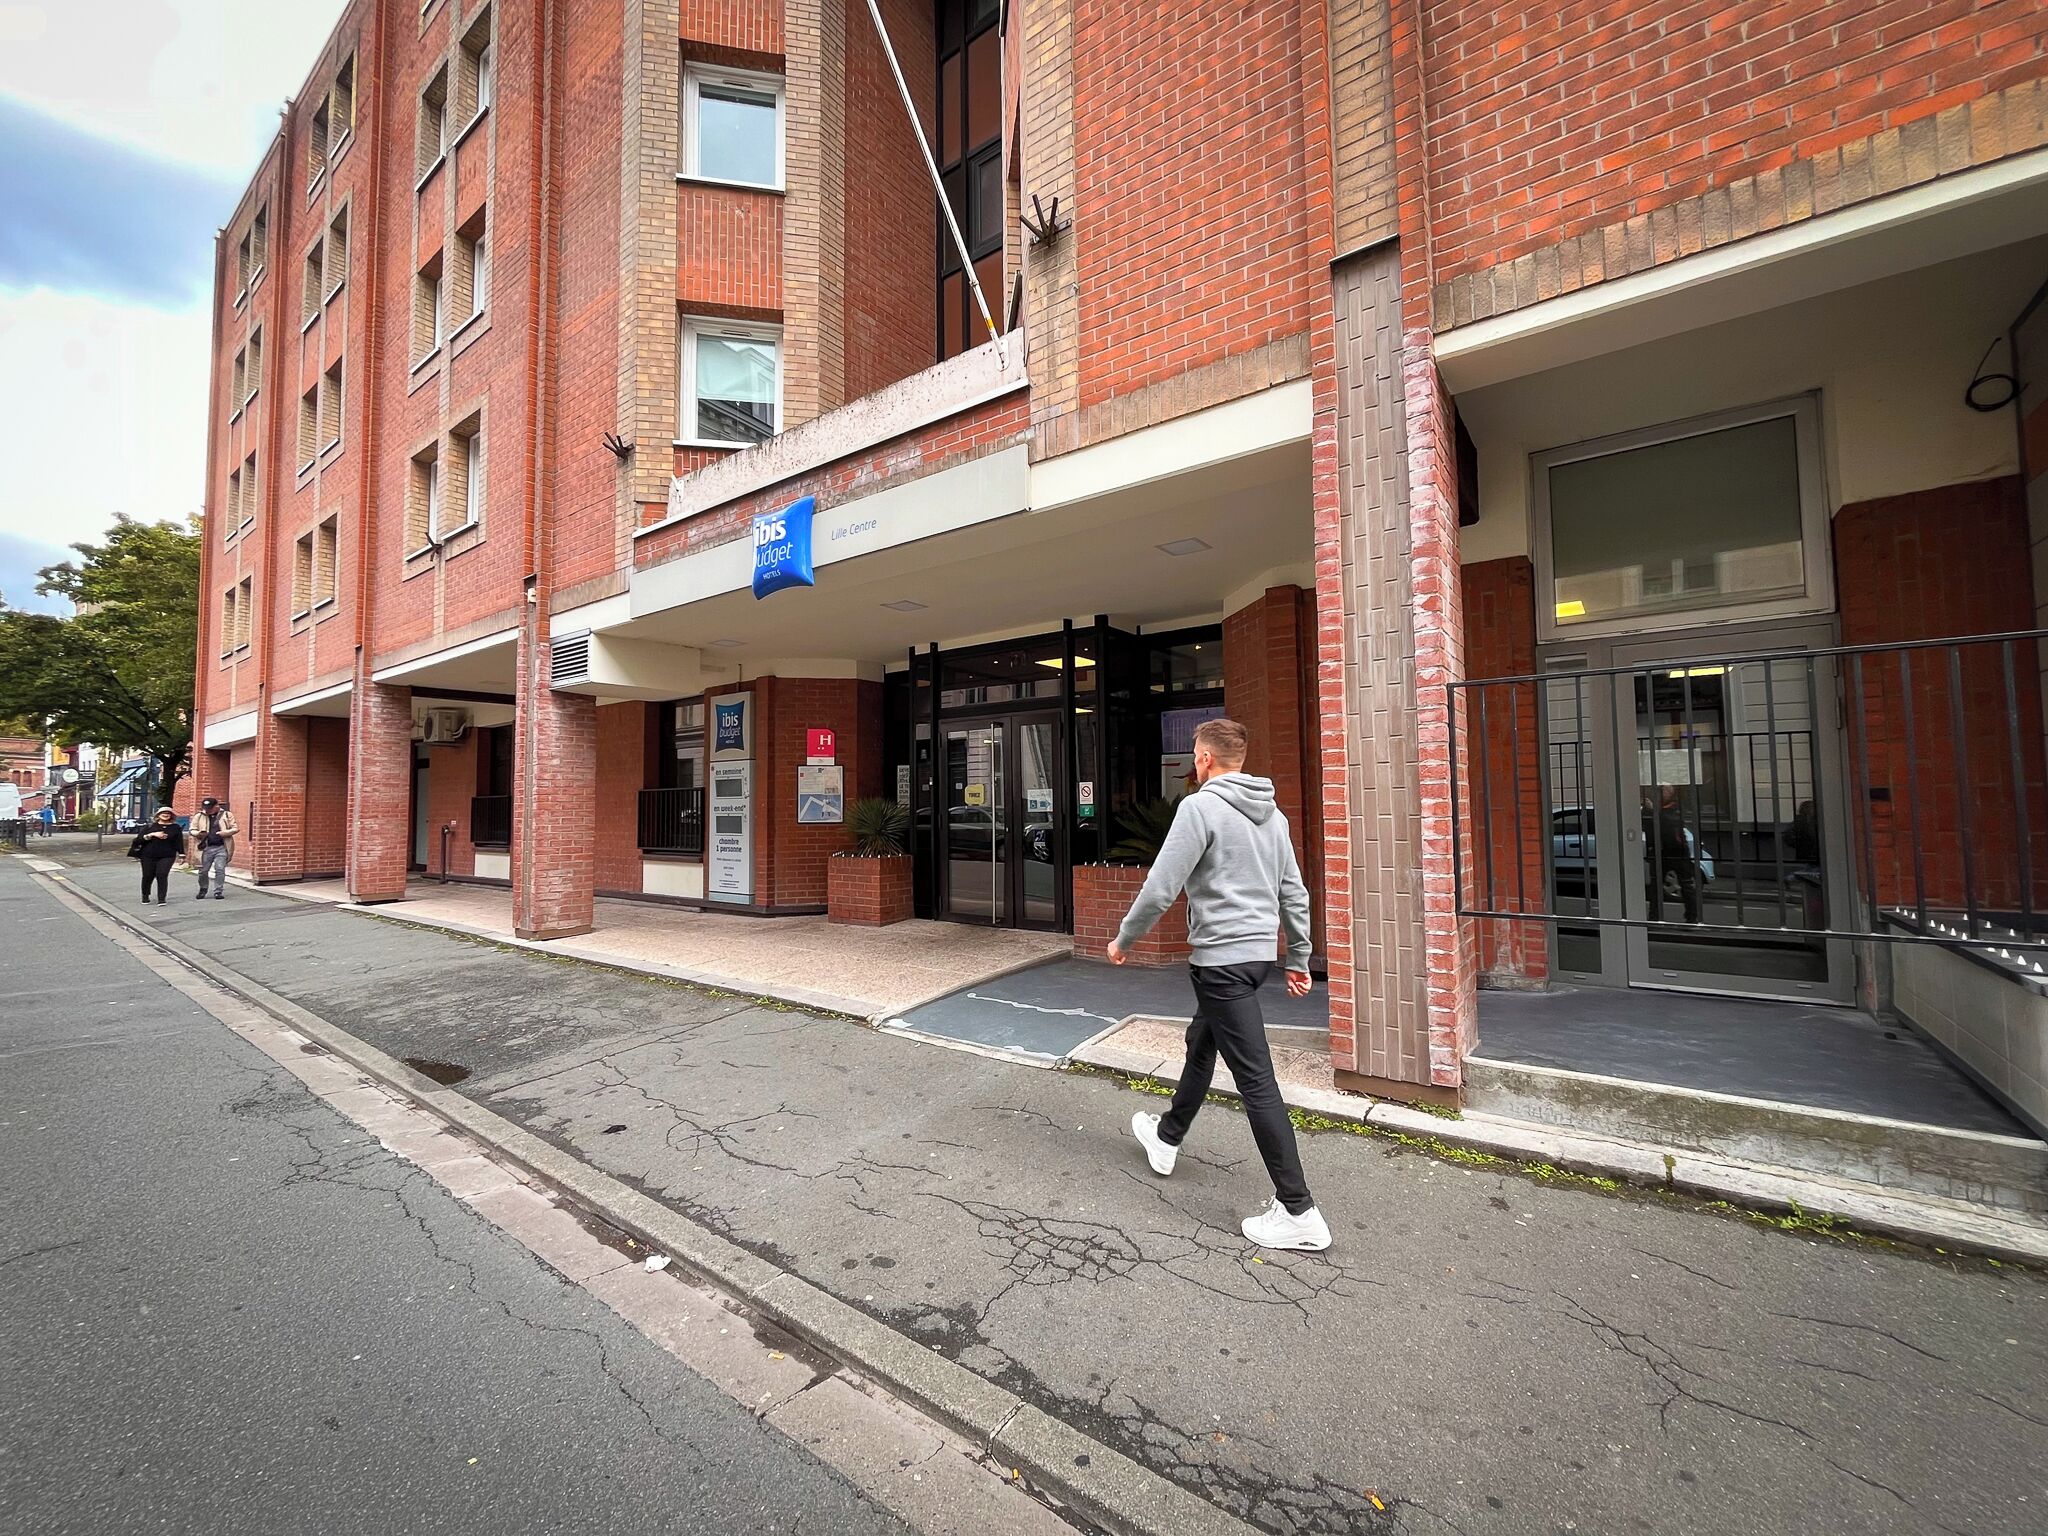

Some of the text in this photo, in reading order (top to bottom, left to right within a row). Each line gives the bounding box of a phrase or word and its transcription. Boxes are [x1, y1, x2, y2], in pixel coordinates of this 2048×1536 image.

[754, 516, 787, 546] ibis
[831, 519, 877, 541] Lille Centre
[762, 569, 781, 580] HOTELS
[722, 713, 739, 727] ibis
[719, 727, 741, 739] budget
[820, 735, 832, 745] H
[720, 846, 742, 854] personne
